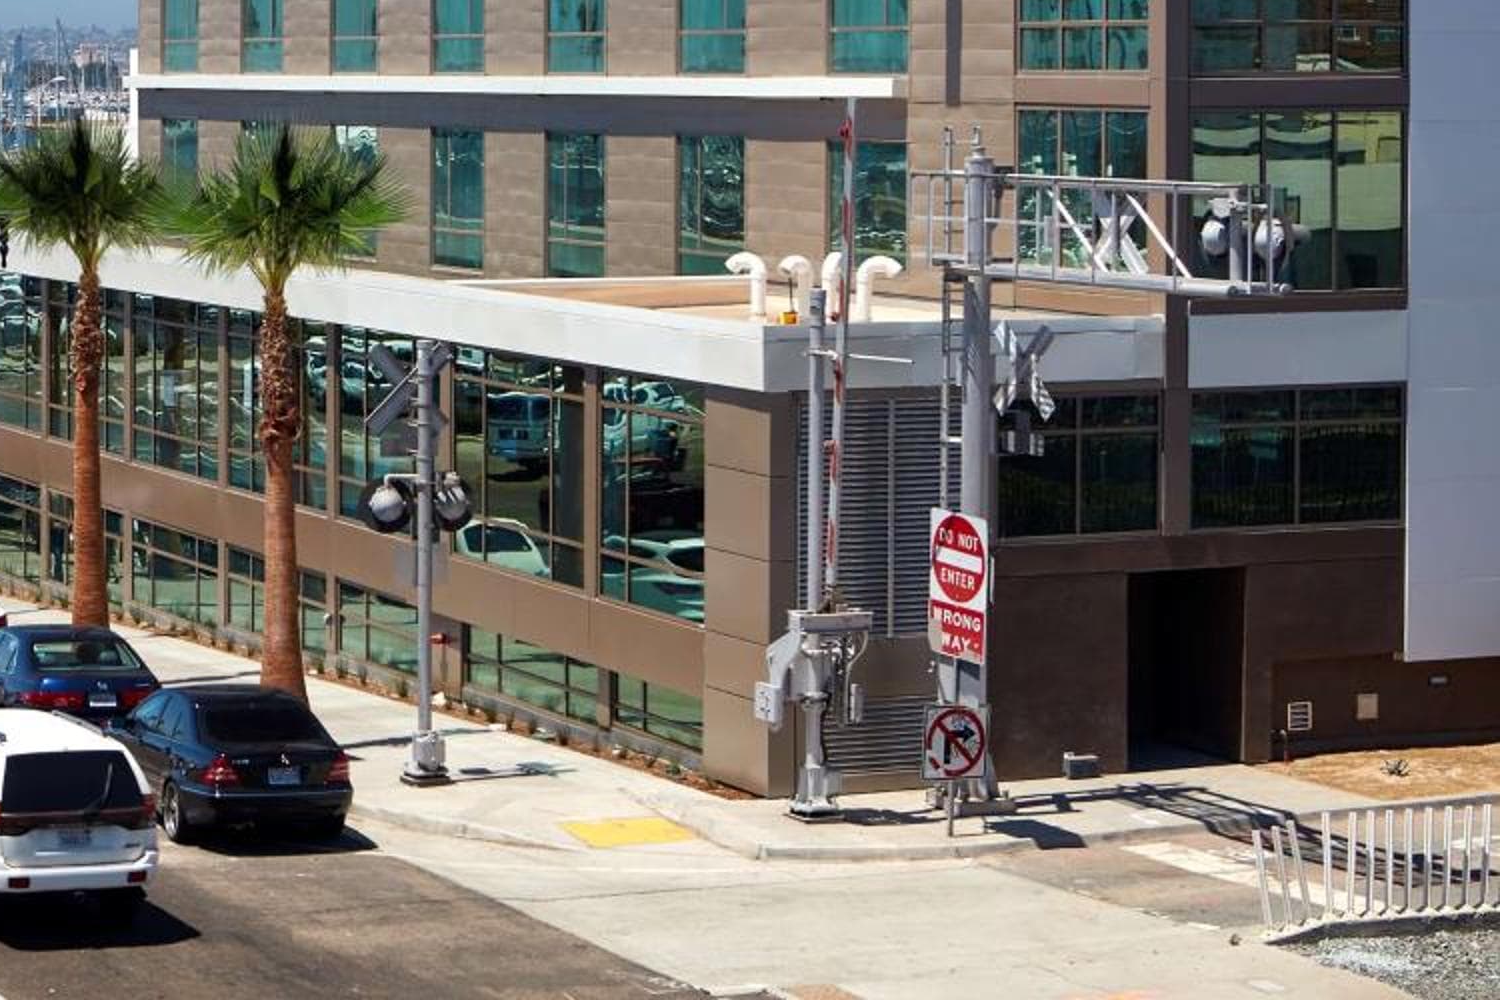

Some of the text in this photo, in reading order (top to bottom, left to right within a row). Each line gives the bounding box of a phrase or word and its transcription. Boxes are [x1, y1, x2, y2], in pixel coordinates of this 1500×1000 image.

[939, 527, 979, 551] DO NOT
[940, 569, 975, 590] ENTER
[933, 605, 981, 632] WRONG
[940, 632, 970, 651] WAY
